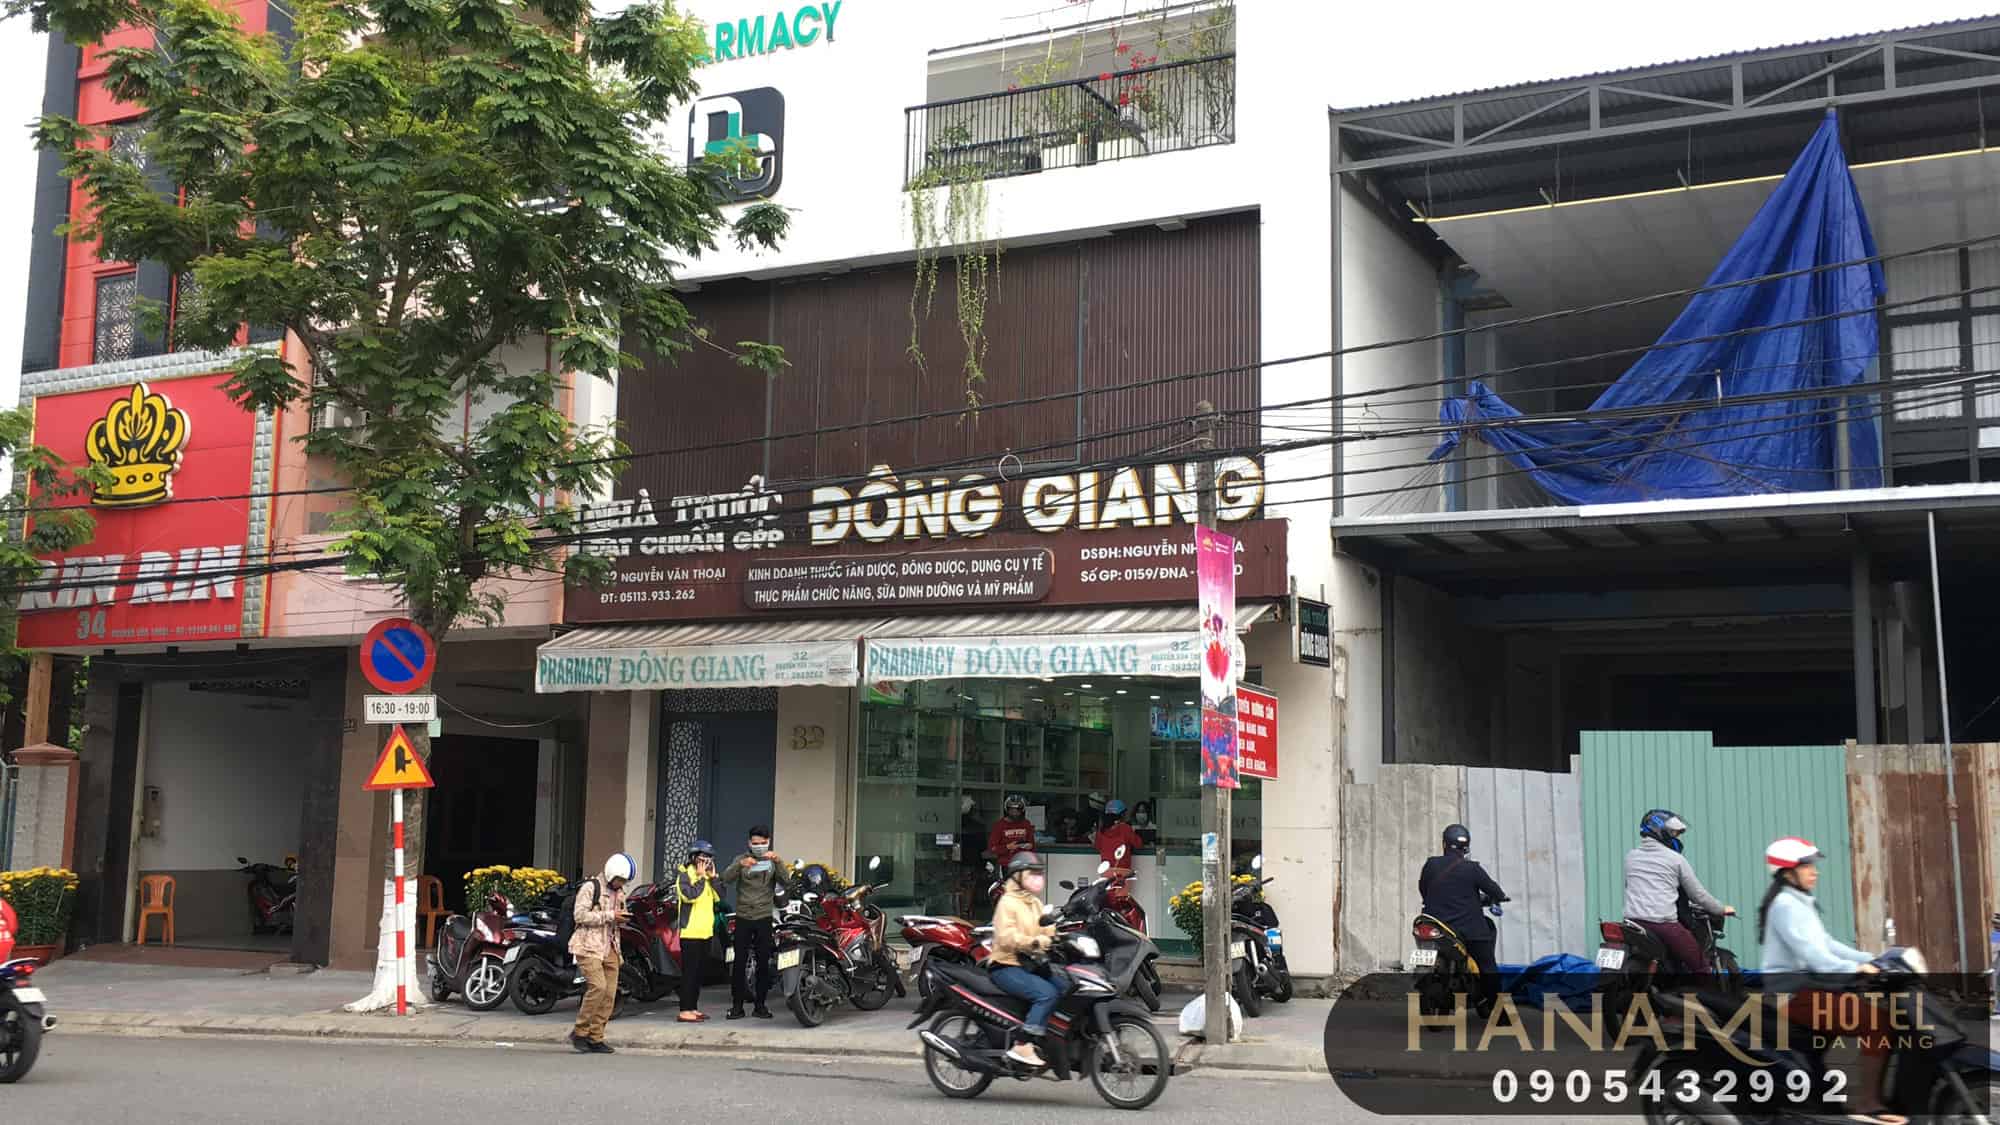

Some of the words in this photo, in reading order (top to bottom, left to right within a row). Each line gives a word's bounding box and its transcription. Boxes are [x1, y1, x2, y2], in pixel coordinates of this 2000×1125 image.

[689, 0, 842, 66] ARMACY
[808, 464, 1002, 546] ĐÔNG
[1021, 456, 1266, 533] GIANG
[733, 530, 785, 551] GPP
[1080, 547, 1121, 561] DSĐH:
[1123, 539, 1178, 557] NGUYỄN
[621, 566, 664, 582] NGUYỄN
[667, 567, 689, 581] VĂN
[693, 567, 726, 581] THOẠI
[748, 567, 771, 582] KINH
[773, 566, 808, 580] DOANH
[866, 563, 899, 579] DƯỢC,
[902, 560, 933, 576] ĐÔNG
[935, 560, 969, 577] DƯỢC,
[971, 558, 1001, 575] DỤNG
[1004, 558, 1020, 572] CỤ
[1022, 557, 1030, 570] Y
[1031, 552, 1044, 570] TẾ
[1080, 567, 1097, 582] Số
[1099, 570, 1122, 581] GP:
[1124, 566, 1189, 580] 0159/ĐNA
[620, 589, 696, 603] 05113.933.262
[782, 582, 810, 602] PHẨM
[812, 585, 840, 601] CHỨC
[842, 585, 875, 602] NĂNG,
[877, 581, 897, 599] SỮA
[899, 584, 924, 599] DINH
[926, 581, 964, 598] DƯỠNG
[967, 578, 981, 596] VÀ
[984, 578, 1001, 596] MỸ
[1002, 574, 1034, 595] PHẨM
[77, 610, 107, 639] 34
[539, 656, 613, 685] PHARMACY
[619, 650, 684, 684] ĐÔNG
[691, 653, 767, 682] GIANG
[869, 645, 956, 676] PHARMACY
[964, 639, 1043, 675] ĐÔNG
[1049, 643, 1139, 674] GIANG
[371, 702, 396, 715] 16:30
[405, 702, 430, 714] 19:00
[791, 725, 825, 750] 32
